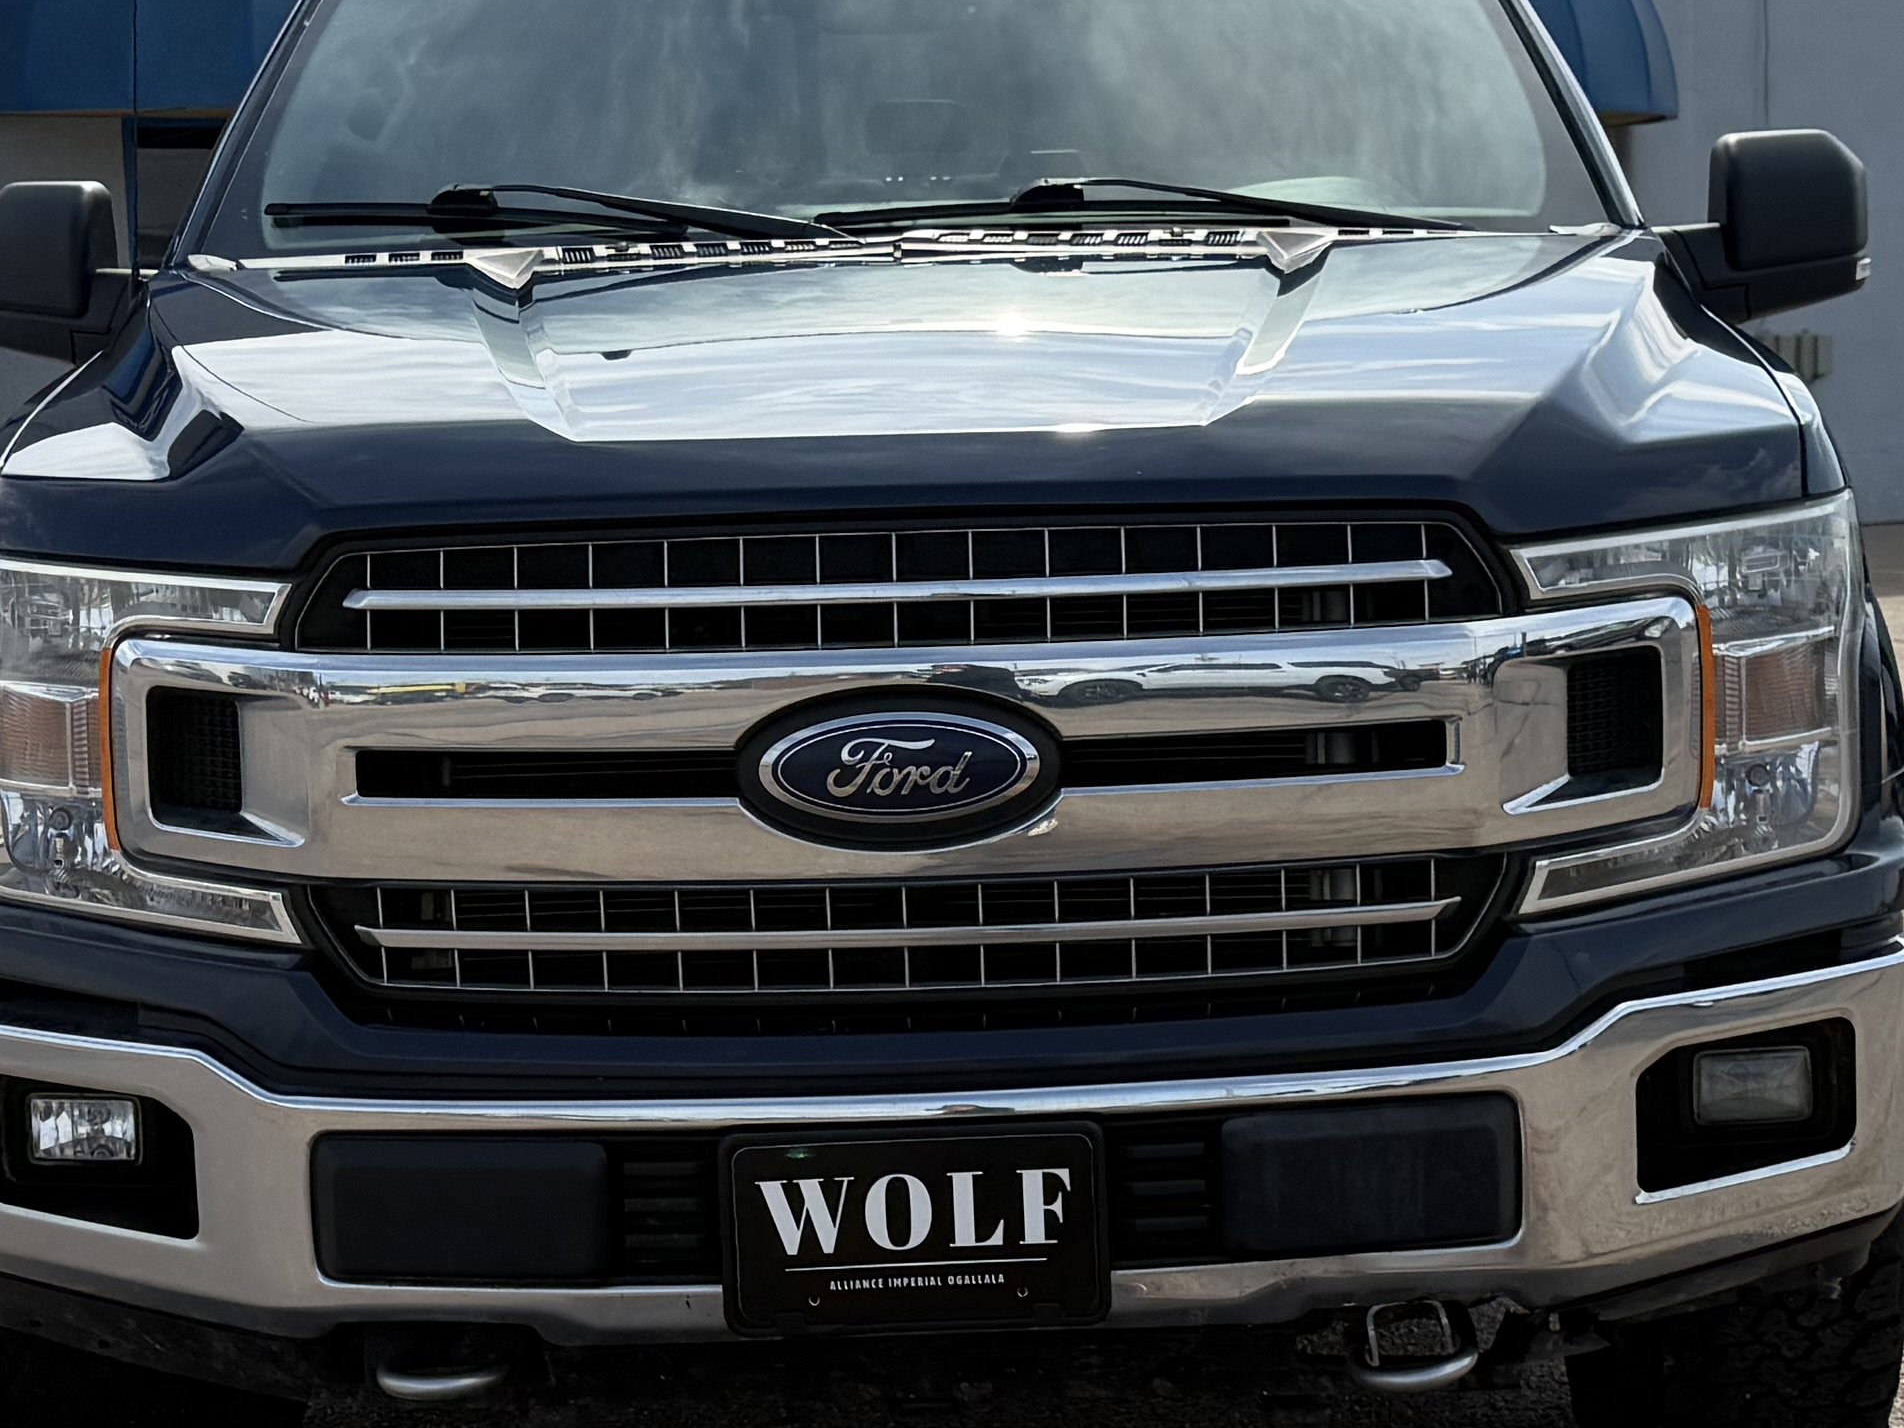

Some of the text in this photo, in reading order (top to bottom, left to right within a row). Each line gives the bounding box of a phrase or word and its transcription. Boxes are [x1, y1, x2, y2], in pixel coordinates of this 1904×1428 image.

[826, 738, 972, 798] Ford
[754, 1168, 1072, 1256] WOLF
[829, 1273, 1006, 1291] ALLIANCE IMPERIAL OGALLALA
